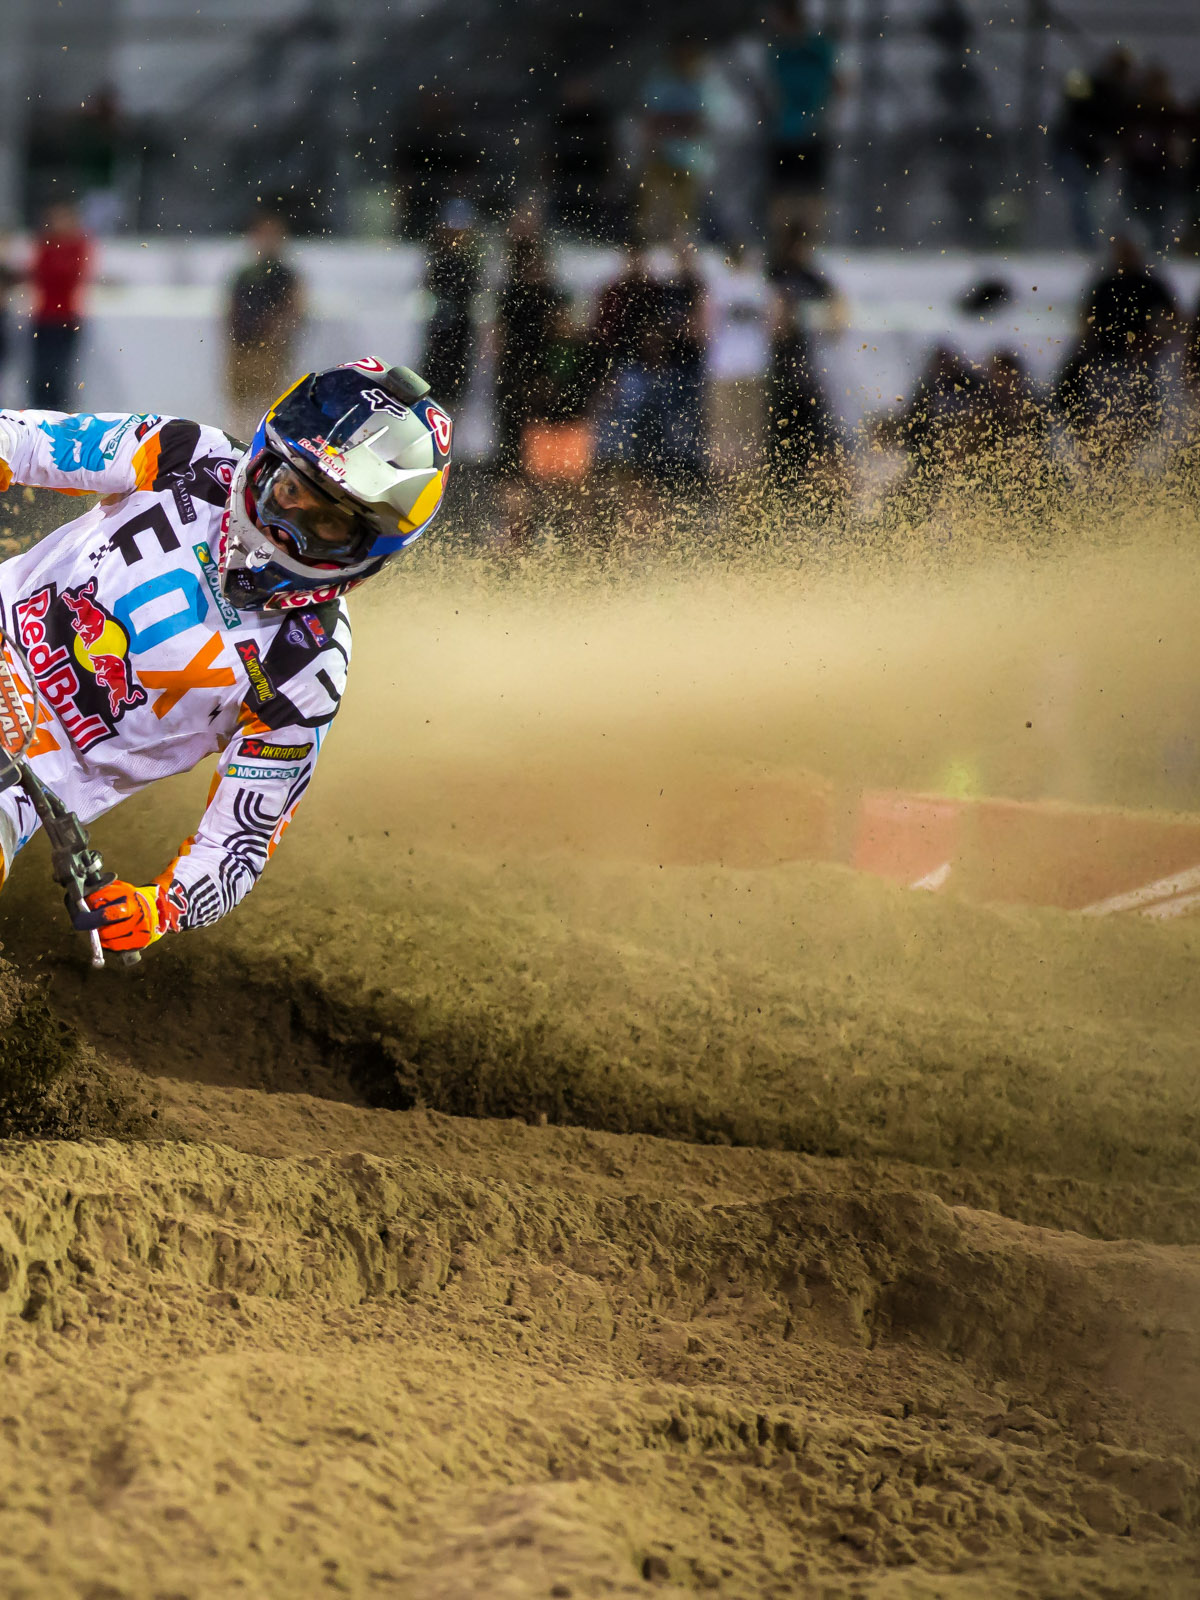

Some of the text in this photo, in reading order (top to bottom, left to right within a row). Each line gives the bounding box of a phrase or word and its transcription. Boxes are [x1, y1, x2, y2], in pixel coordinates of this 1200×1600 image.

[297, 437, 327, 459] Red
[323, 452, 348, 477] Bull
[16, 588, 70, 676] Red
[108, 502, 237, 720] FOX
[36, 663, 112, 750] Bull
[237, 766, 297, 779] MOTOREX
